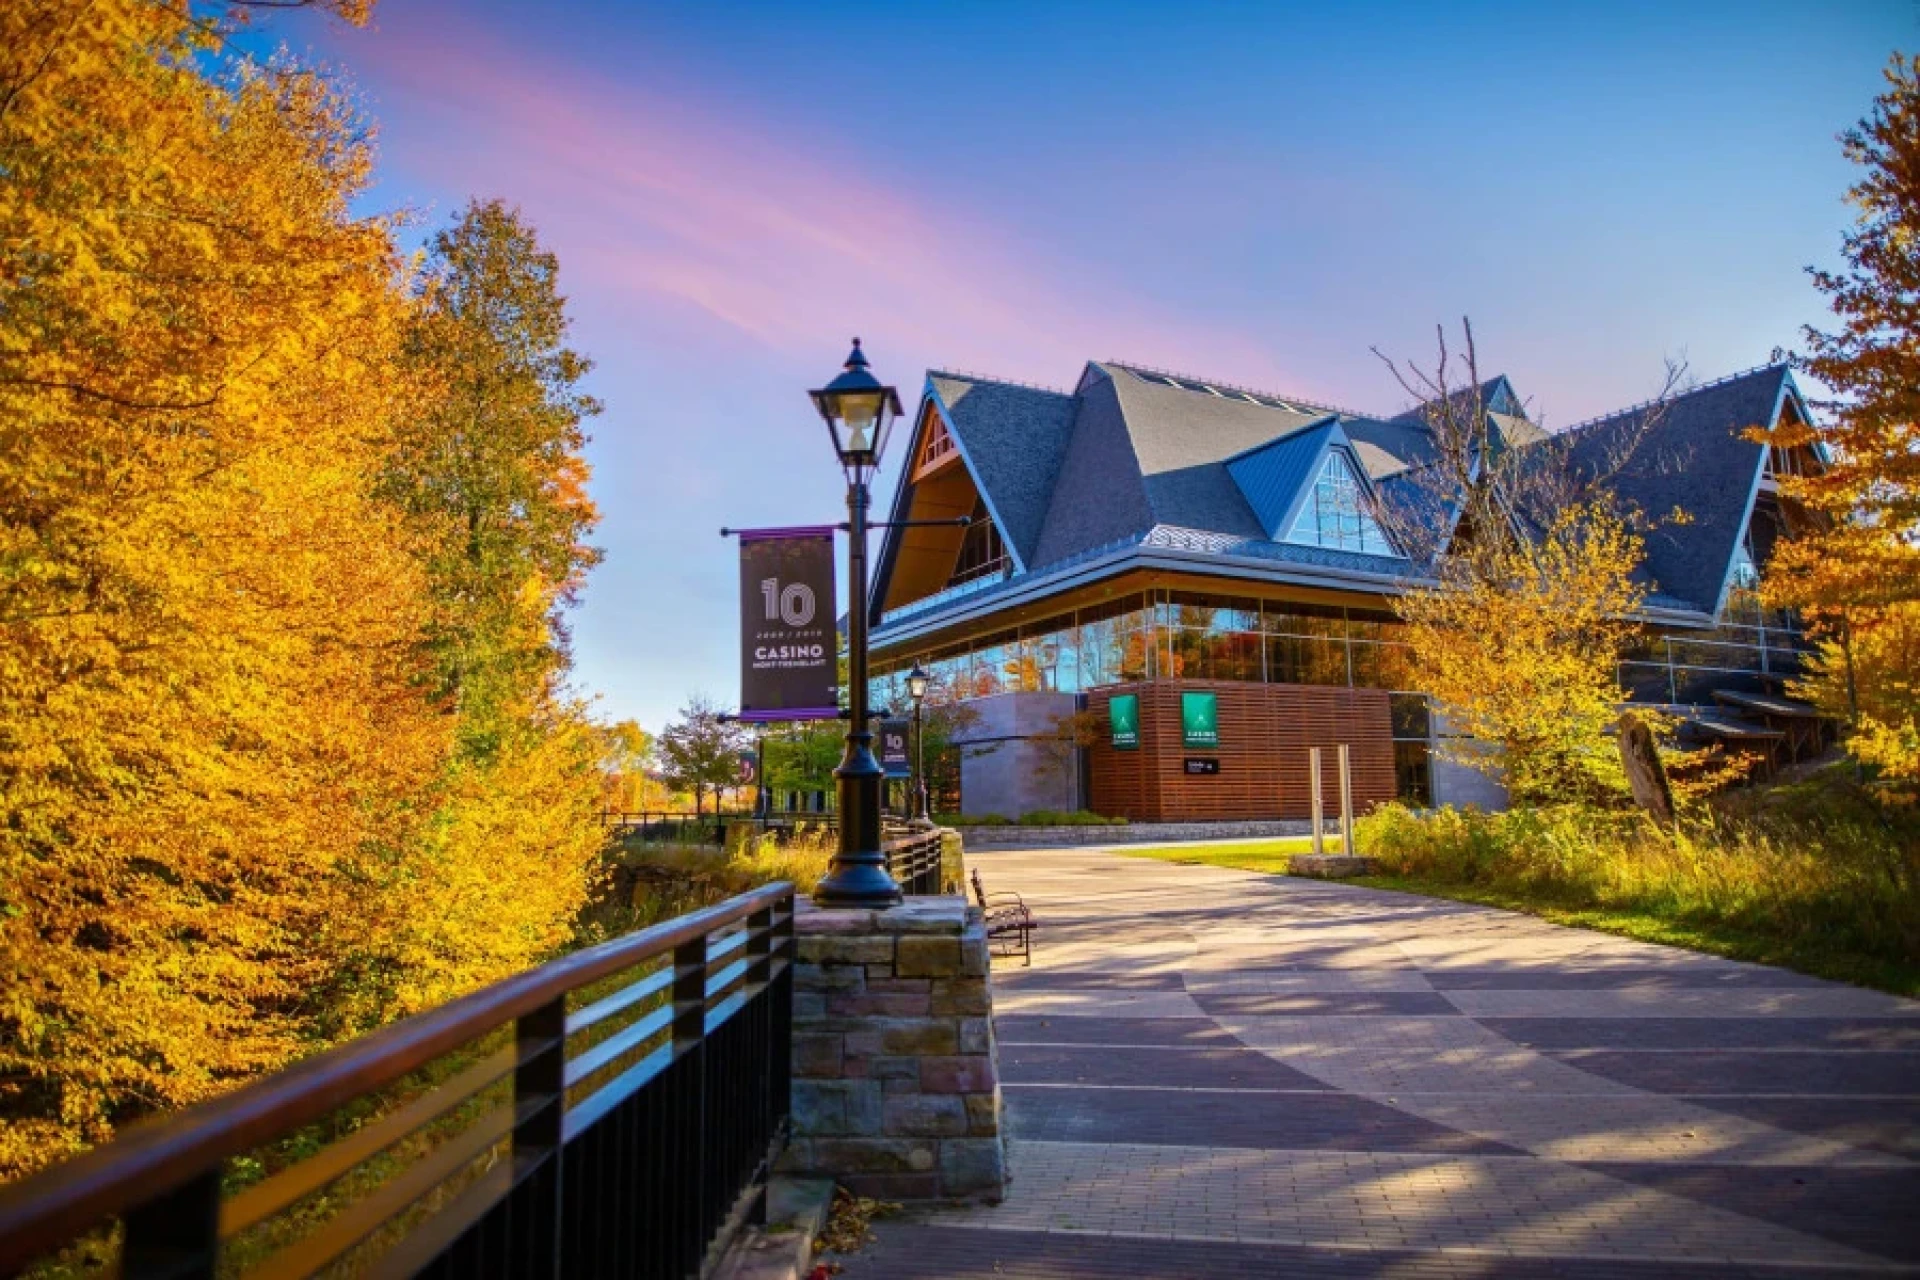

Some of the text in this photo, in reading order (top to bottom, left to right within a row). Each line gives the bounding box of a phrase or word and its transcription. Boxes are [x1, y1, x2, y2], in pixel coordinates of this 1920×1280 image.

[761, 577, 816, 627] 10
[754, 644, 824, 659] CASINO
[884, 733, 904, 750] 10
